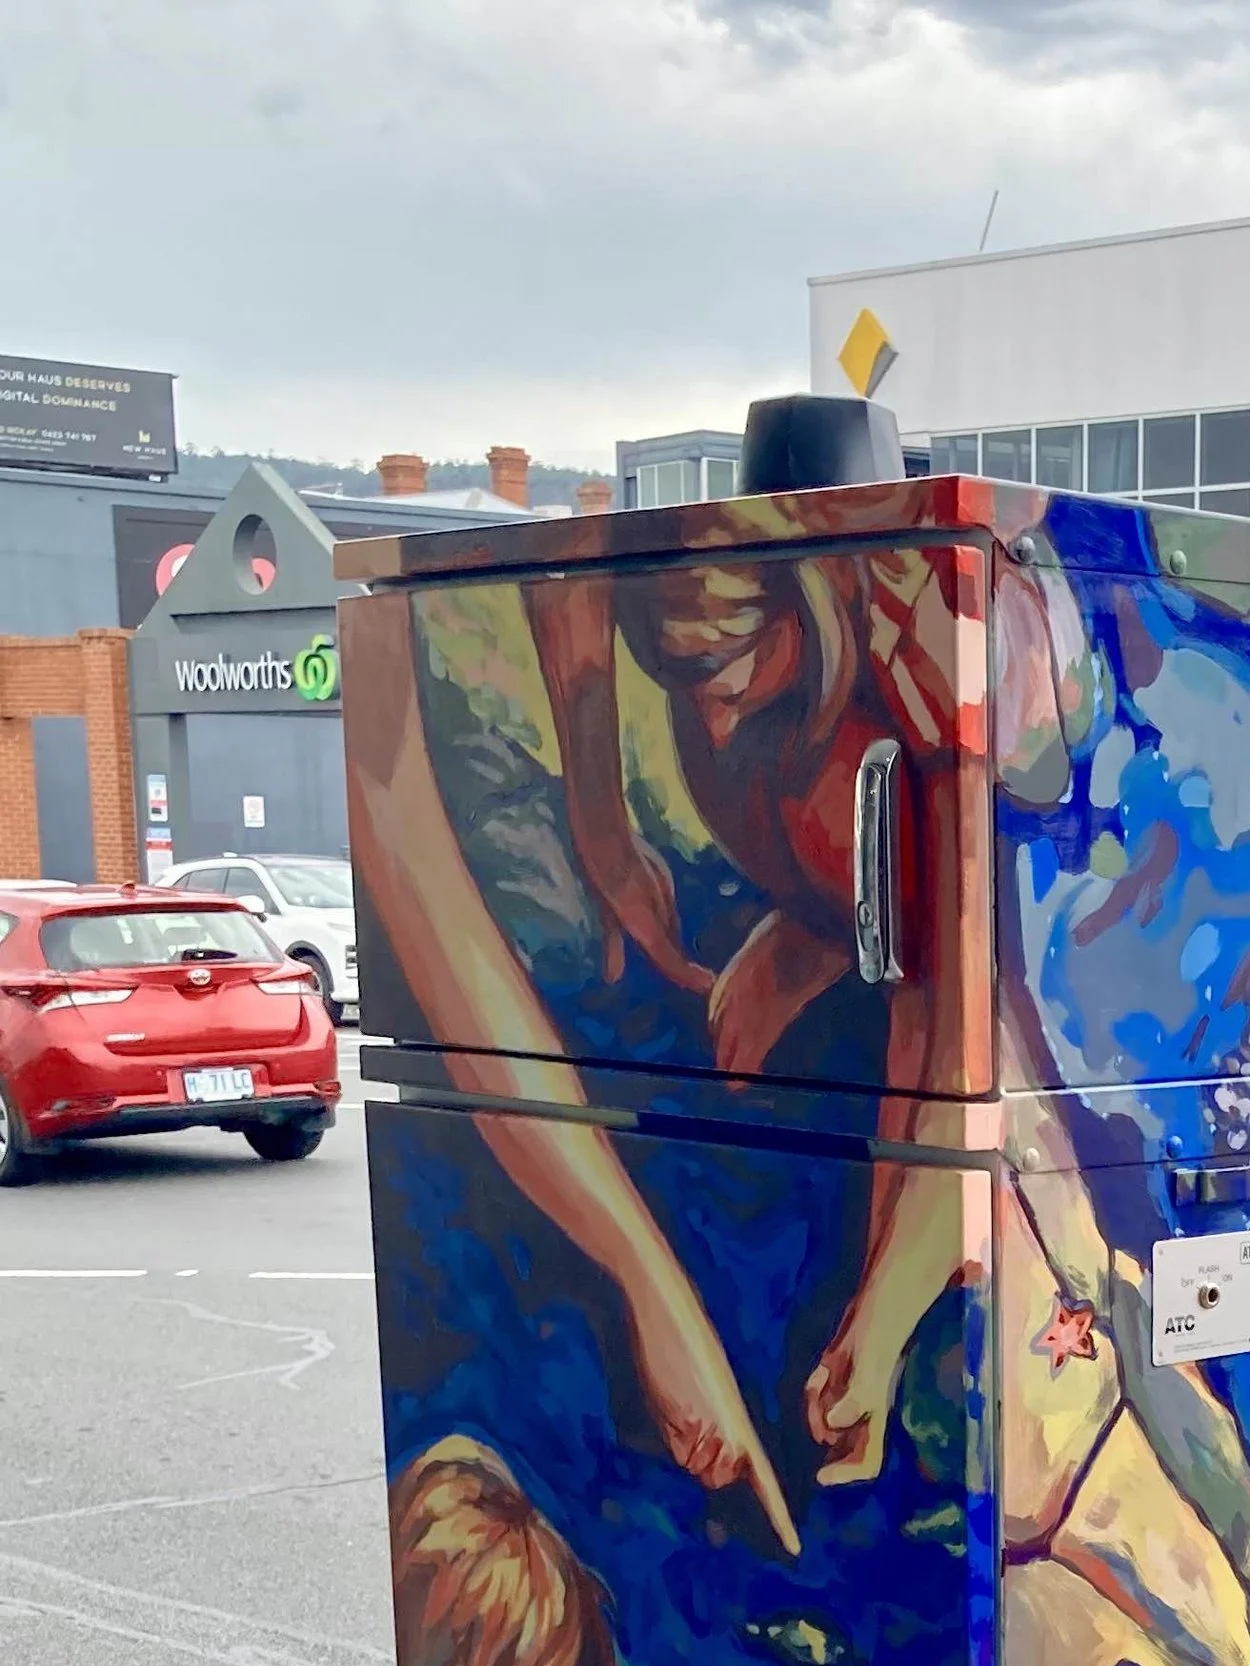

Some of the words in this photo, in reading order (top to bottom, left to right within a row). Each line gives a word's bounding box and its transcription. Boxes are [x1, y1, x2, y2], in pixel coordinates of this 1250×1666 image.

[27, 371, 62, 386] HAUS
[65, 376, 131, 393] DESERVES
[42, 394, 117, 412] DOMINANCE
[174, 650, 292, 692] Woolworths
[1164, 1314, 1195, 1335] ATC
